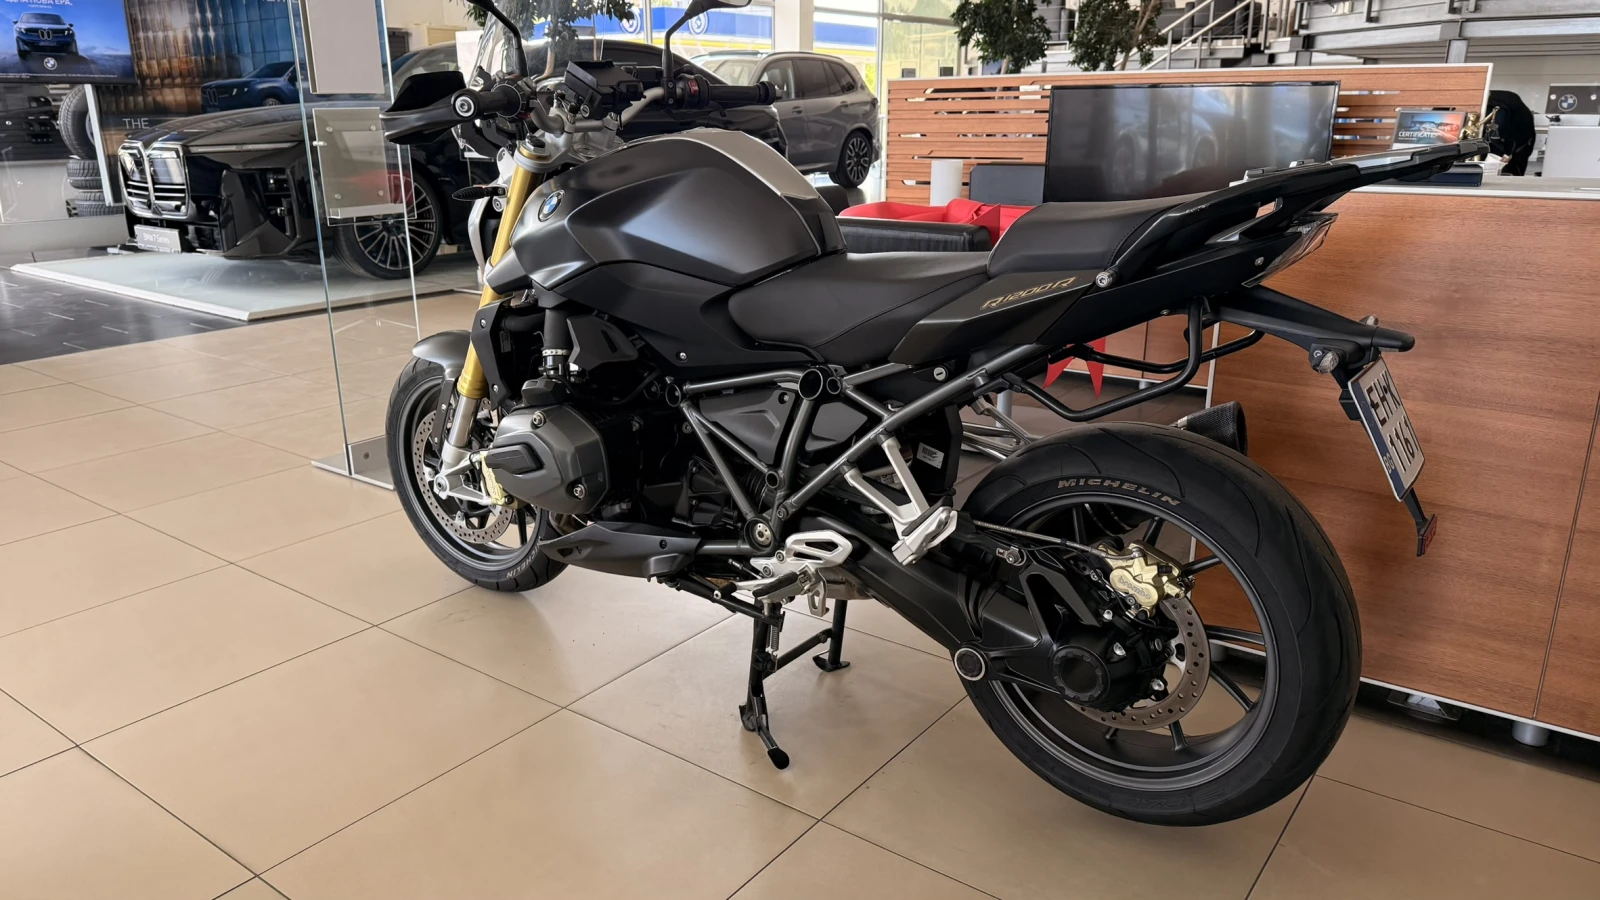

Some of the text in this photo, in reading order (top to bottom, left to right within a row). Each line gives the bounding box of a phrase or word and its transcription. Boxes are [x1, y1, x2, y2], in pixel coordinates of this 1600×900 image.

[121, 117, 150, 129] THE
[1387, 415, 1419, 473] 1161
[1057, 478, 1180, 506] MICHELIN
